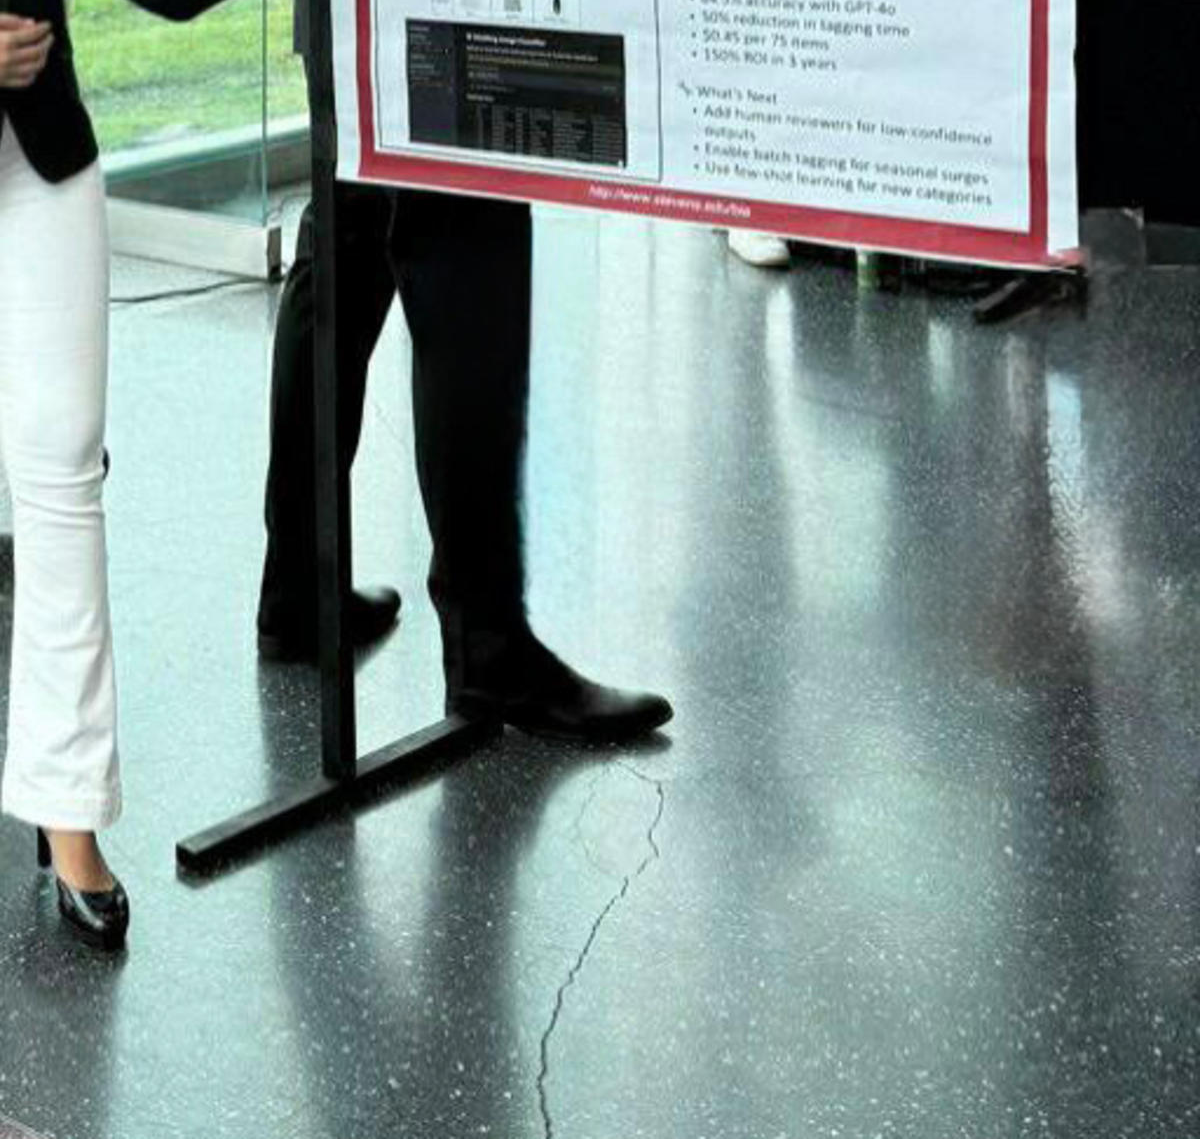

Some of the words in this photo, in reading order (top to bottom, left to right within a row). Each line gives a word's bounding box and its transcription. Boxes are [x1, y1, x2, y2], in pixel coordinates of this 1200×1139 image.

[808, 0, 841, 13] with
[733, 13, 801, 30] reduction
[803, 17, 818, 32] in
[820, 19, 874, 38] tagging
[876, 22, 911, 38] time
[744, 33, 767, 48] per
[771, 53, 785, 66] in
[800, 57, 838, 71] years
[746, 88, 778, 105] Next
[704, 104, 732, 119] Add
[735, 107, 783, 124] human
[856, 119, 876, 134] for
[704, 141, 751, 159] Enable
[795, 153, 848, 174] tagging
[850, 158, 871, 172] for
[874, 161, 939, 181] seasonal
[941, 168, 989, 186] surges
[704, 161, 731, 176] Use
[796, 169, 855, 193] learning
[856, 177, 878, 193] for
[881, 182, 913, 198] new
[915, 187, 993, 207] categories
